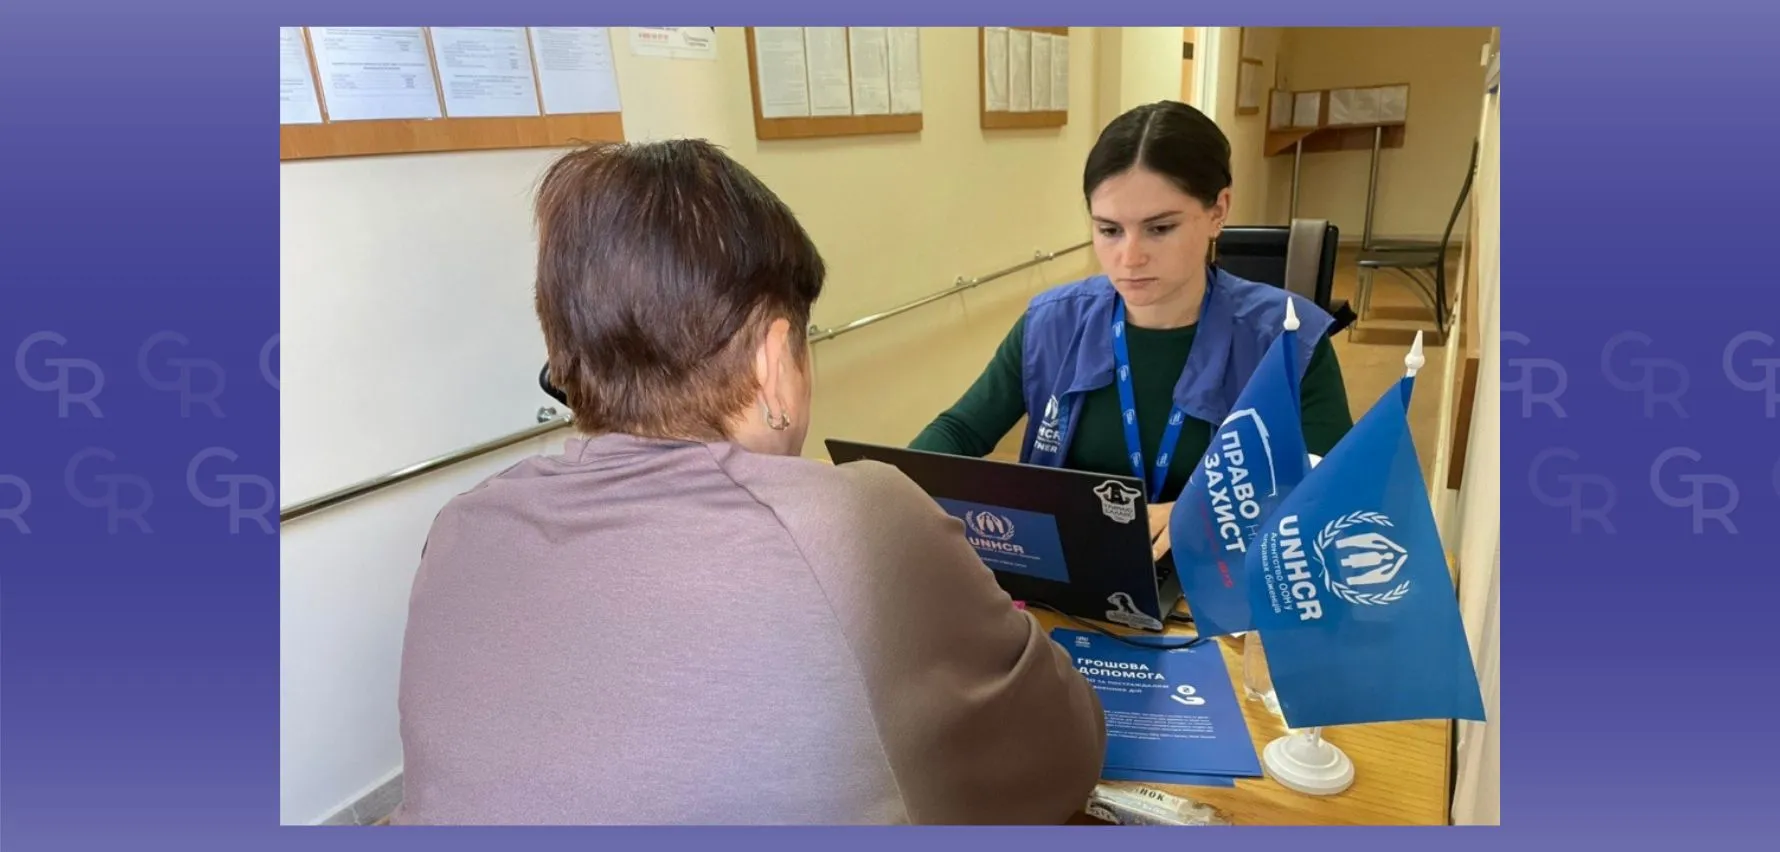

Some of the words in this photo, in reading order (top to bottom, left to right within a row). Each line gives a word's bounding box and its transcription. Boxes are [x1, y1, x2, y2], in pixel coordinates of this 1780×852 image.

[1205, 453, 1246, 553] ЗАХИСТ
[1222, 431, 1260, 519] ПРАВО
[969, 537, 1025, 554] UNHCR
[1270, 532, 1284, 581] Агентство
[1279, 583, 1292, 604] ООН
[1279, 515, 1323, 621] UNHCR
[1077, 658, 1149, 671] ГРОШОВА
[1079, 667, 1165, 680] ДОПОМОГА
